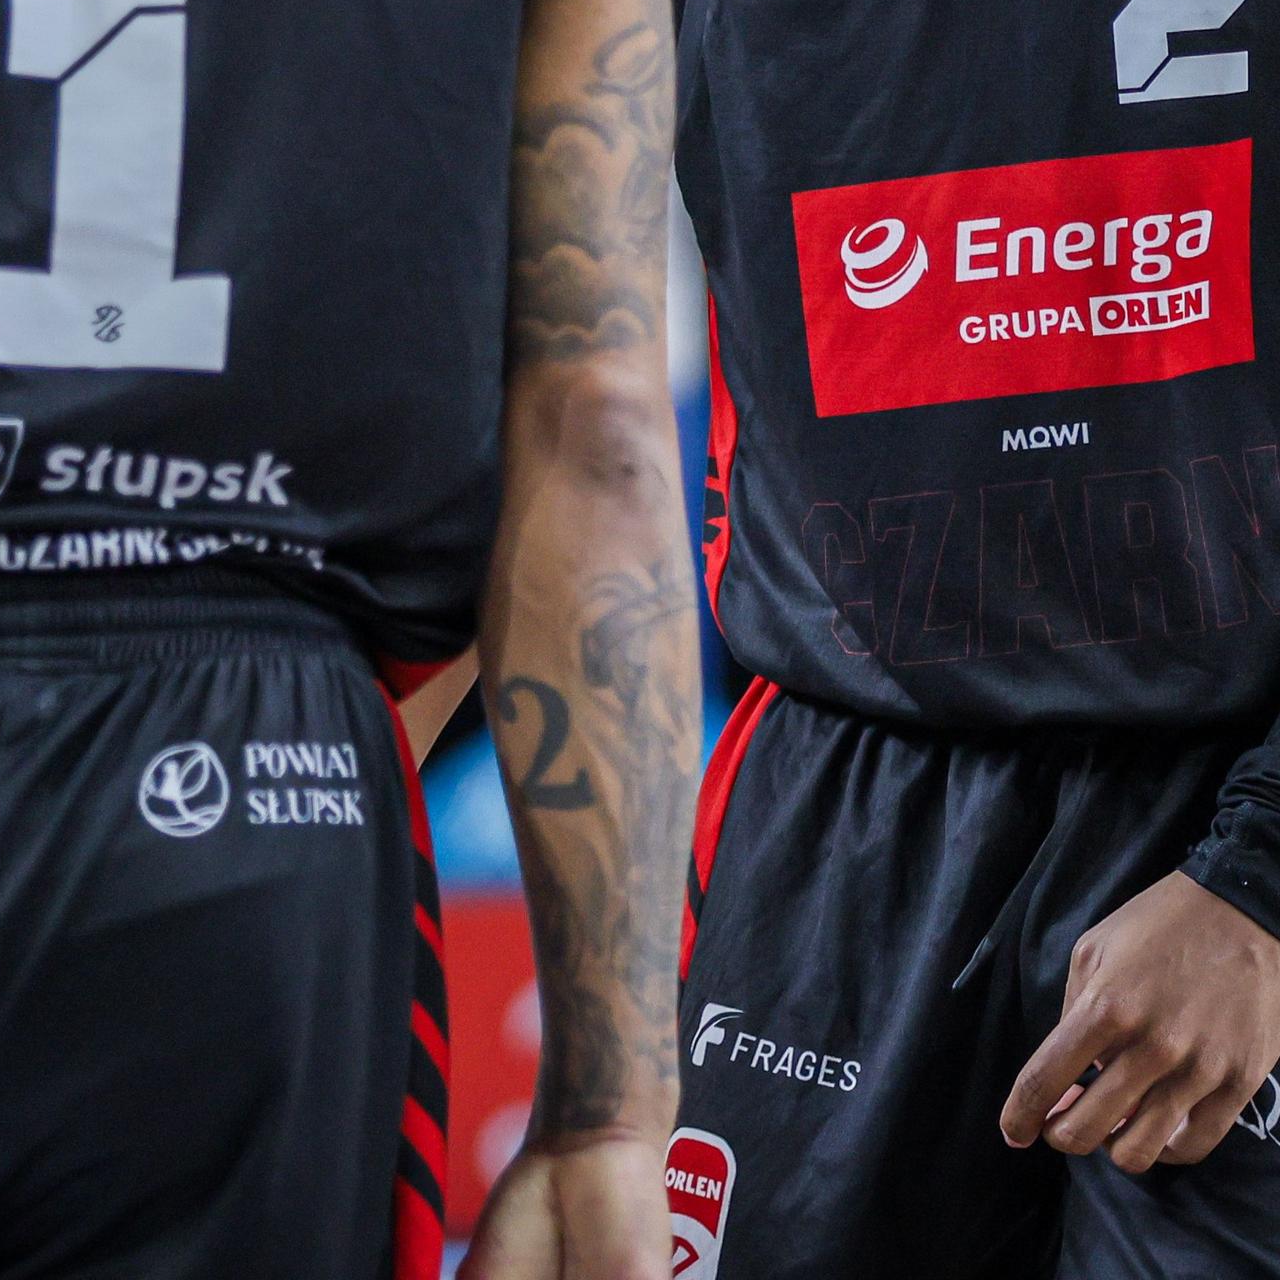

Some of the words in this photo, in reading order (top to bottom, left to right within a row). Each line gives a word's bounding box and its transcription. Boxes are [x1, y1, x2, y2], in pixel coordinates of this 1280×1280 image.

[954, 209, 1214, 284] Energa
[958, 306, 1086, 345] GRUPA
[1097, 286, 1204, 330] ORLEN
[41, 441, 293, 510] Słupsk
[495, 675, 596, 810] 2
[730, 1031, 862, 1093] FRAGES
[664, 1166, 723, 1202] ORLEN
